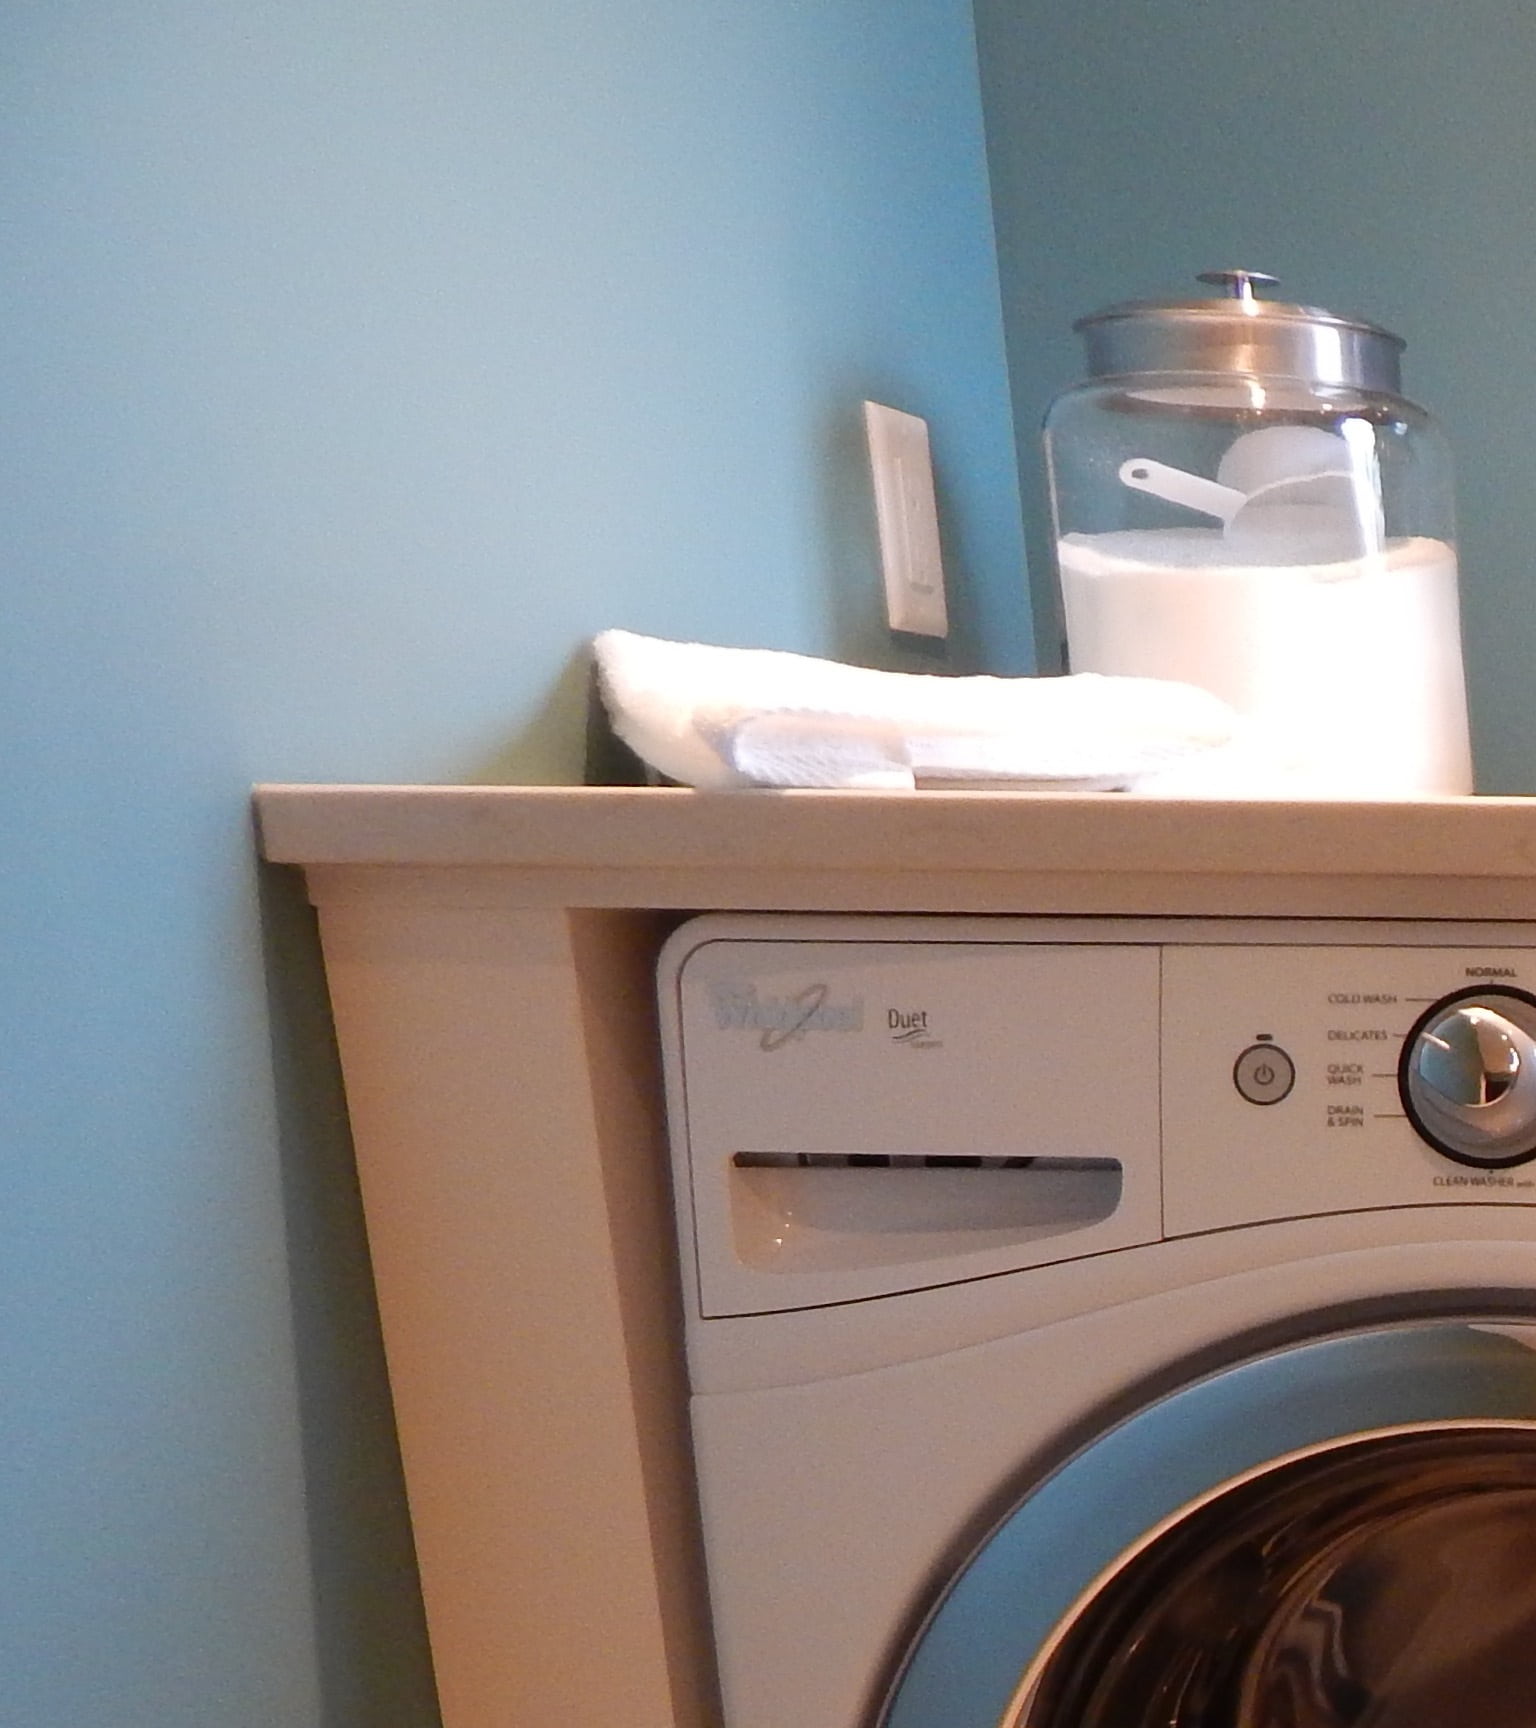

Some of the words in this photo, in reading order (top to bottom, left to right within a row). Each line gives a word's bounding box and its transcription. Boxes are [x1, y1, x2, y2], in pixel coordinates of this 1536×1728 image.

[1465, 967, 1517, 978] NORMAL
[1327, 993, 1361, 1005] COLD
[1363, 993, 1398, 1005] WASH
[888, 1008, 928, 1029] Duet
[1327, 1029, 1388, 1042] DELICATES
[1327, 1064, 1364, 1074] QUICK
[1327, 1074, 1362, 1085] WASH
[1327, 1105, 1364, 1115] DRAIN
[1338, 1116, 1364, 1127] SPIN
[1432, 1175, 1469, 1187] CLEAN
[1470, 1175, 1515, 1187] WASHER
